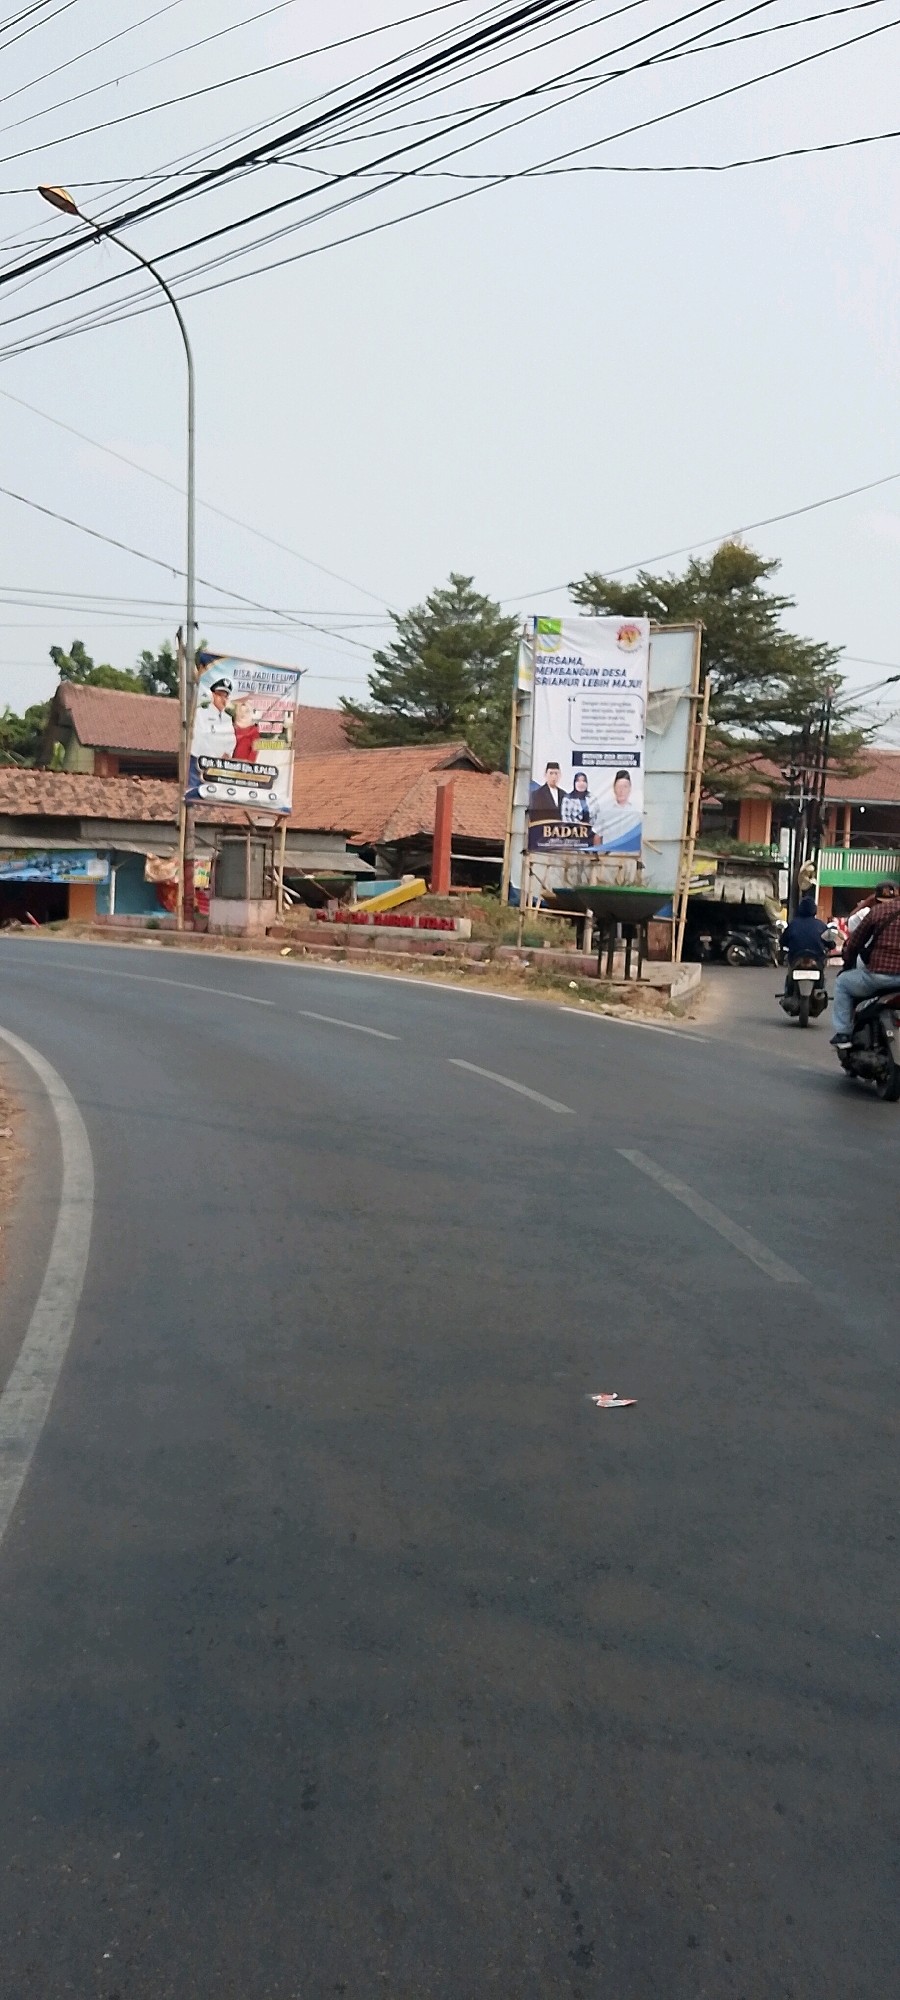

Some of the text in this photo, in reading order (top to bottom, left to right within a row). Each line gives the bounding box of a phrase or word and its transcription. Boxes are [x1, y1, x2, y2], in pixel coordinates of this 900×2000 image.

[536, 656, 585, 666] BERSAMA,
[233, 669, 251, 679] BISA
[535, 667, 627, 678] MEMBANGUN DESA
[535, 677, 579, 687] SRIAMUR
[582, 679, 610, 688] LEBIH
[543, 825, 588, 838] BADAR
